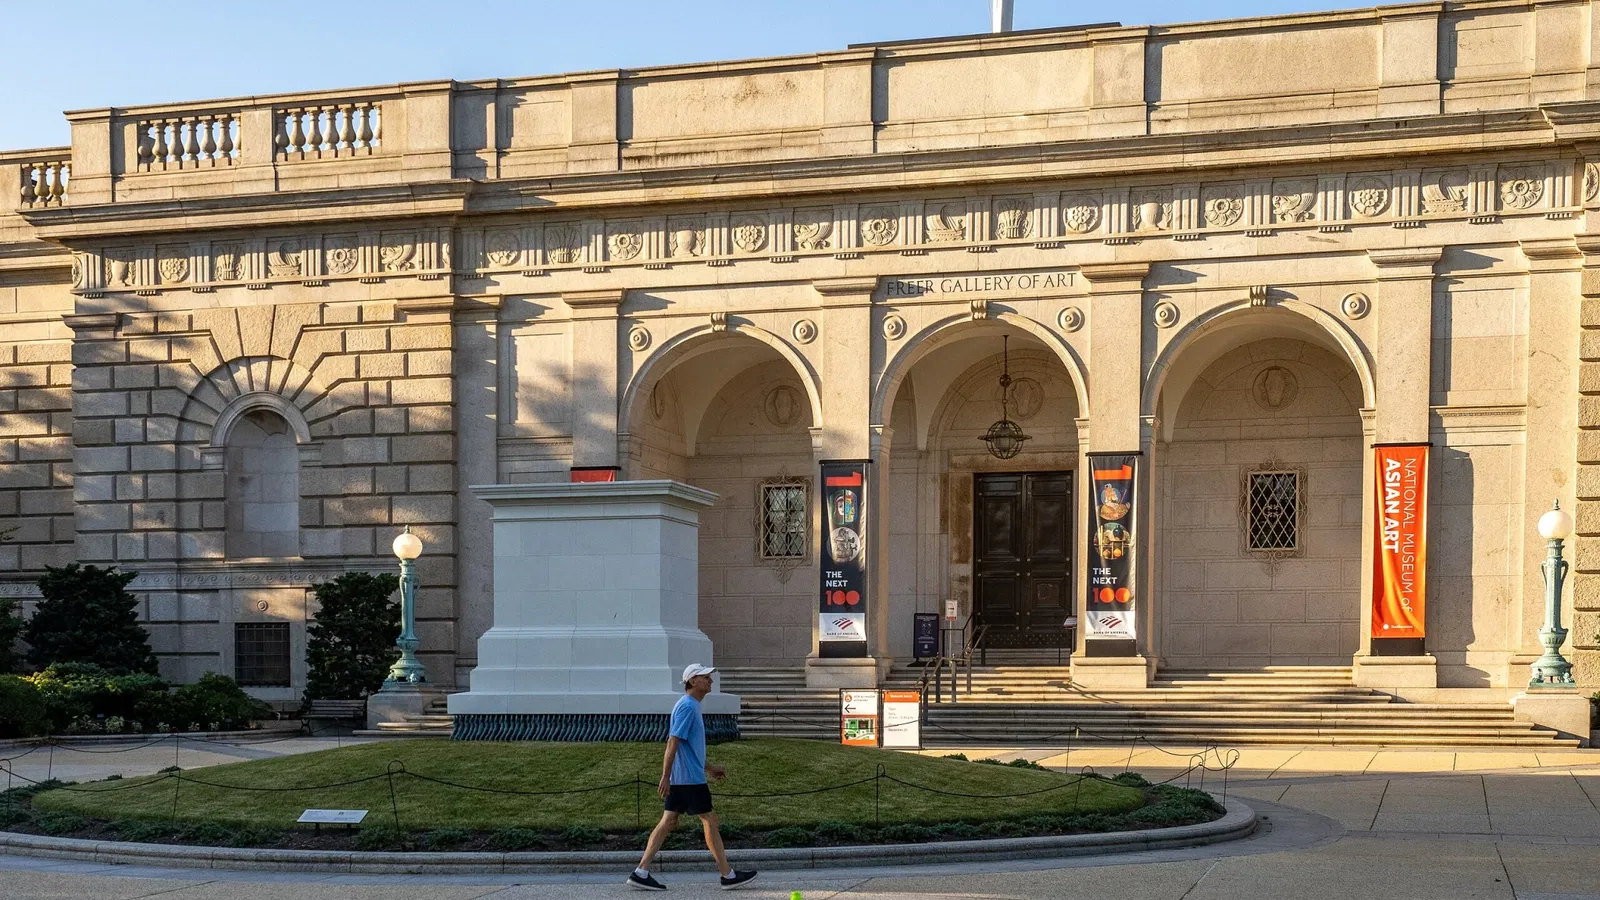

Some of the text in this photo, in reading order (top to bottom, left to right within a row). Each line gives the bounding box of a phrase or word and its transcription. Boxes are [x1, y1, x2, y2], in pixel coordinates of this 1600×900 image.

[886, 272, 1077, 296] FREER GALLERY OF ART
[1402, 458, 1417, 529] NATIONAL
[1383, 458, 1401, 553] ASIAN ART
[1092, 567, 1112, 575] THE
[1401, 533, 1415, 593] MUSEUM
[825, 570, 843, 578] THE
[1092, 577, 1118, 585] NEXT
[825, 580, 848, 588] NEXT
[825, 590, 860, 606] 100
[1092, 587, 1131, 604] 100
